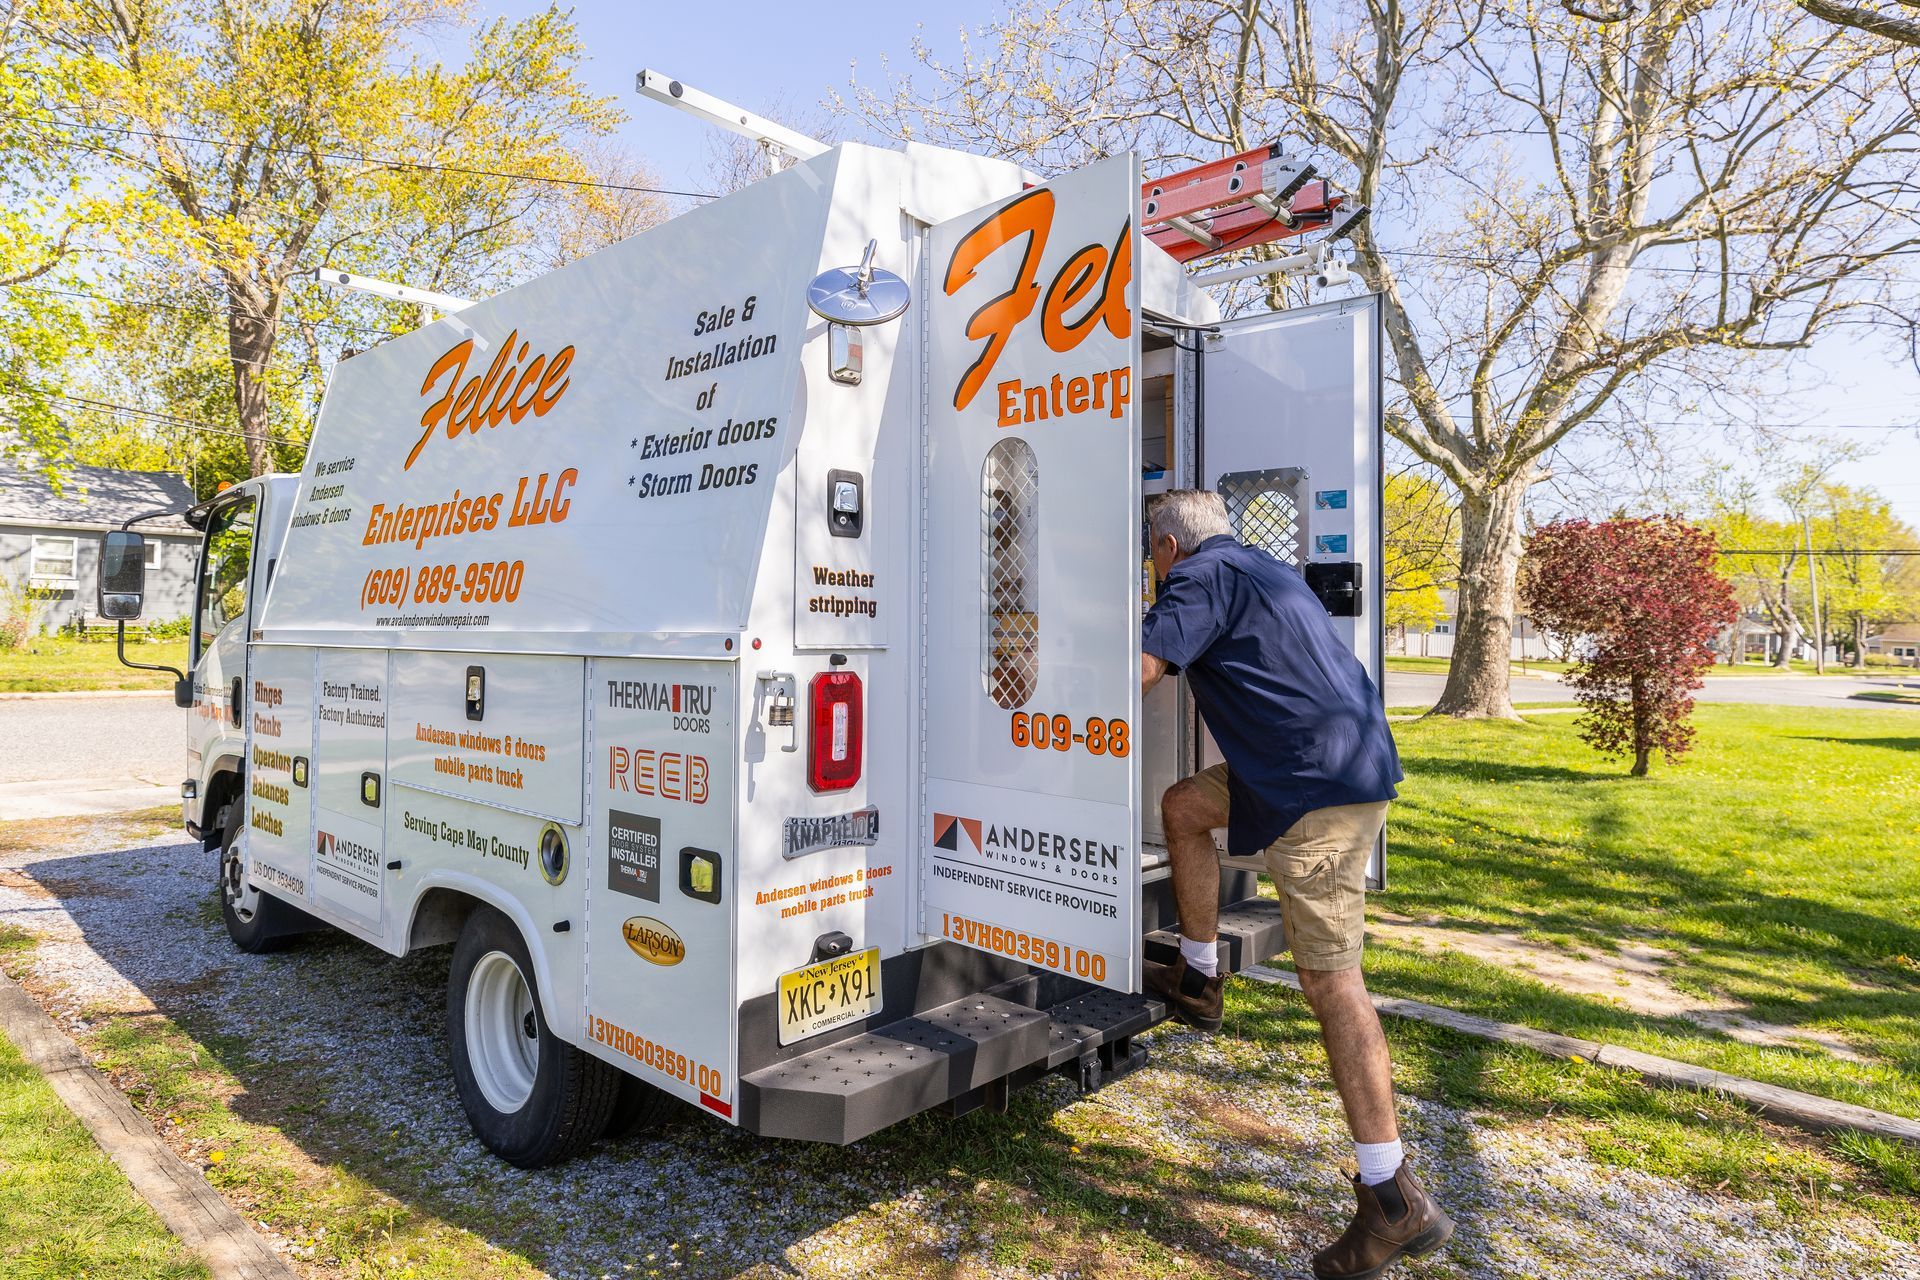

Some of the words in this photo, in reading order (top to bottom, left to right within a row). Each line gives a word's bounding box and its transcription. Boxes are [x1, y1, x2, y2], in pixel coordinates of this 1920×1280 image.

[693, 305, 736, 336] Sale
[741, 295, 757, 322] &
[665, 334, 777, 381] Installation
[404, 328, 576, 471] Felice
[696, 382, 718, 411] of
[997, 365, 1131, 428] Enterp
[640, 426, 713, 460] Exterior
[717, 417, 778, 447] doors
[314, 461, 327, 478] We
[326, 456, 355, 475] service
[638, 472, 693, 499] Storm
[698, 463, 759, 491] Doors
[309, 484, 345, 502] Andersen
[362, 489, 504, 550] Enterprises
[507, 468, 579, 528] LLC
[290, 511, 321, 528] windows
[321, 508, 329, 524] &
[328, 507, 352, 523] doors
[360, 566, 410, 611] (609)
[413, 560, 525, 604] 889-9500
[813, 566, 875, 588] Weather
[375, 613, 490, 629] www.avalondoorwindowrepair.com
[809, 595, 877, 618] stripping
[254, 681, 283, 709] Hinges
[323, 681, 349, 702] Factory
[607, 680, 671, 712] THERMA
[254, 712, 281, 738] Cranks
[319, 704, 344, 726] Factory
[346, 707, 385, 728] Authorized
[673, 716, 710, 734] DOORS
[415, 722, 456, 747] Andersen
[459, 730, 501, 754] windows
[504, 735, 512, 756] &
[515, 738, 546, 761] doors
[1011, 711, 1130, 758] 609-88
[253, 743, 291, 773] Operators
[434, 756, 465, 777] mobile
[468, 764, 493, 783] parts
[496, 766, 524, 789] truck
[252, 774, 289, 806] Balances
[609, 745, 709, 804] REEB
[251, 806, 283, 837] Latches
[611, 826, 658, 847] CERTIFIED
[788, 811, 876, 854] KNAPHEIDE
[335, 838, 379, 867] ANDERSEN
[404, 811, 438, 841] Serving
[440, 821, 464, 848] Cape
[467, 829, 488, 858] May
[491, 836, 530, 870] County
[611, 838, 629, 849] DOOR
[631, 843, 657, 855] SYSTEM
[253, 860, 263, 876] US
[263, 864, 276, 882] DOT
[611, 846, 657, 869] INSTALLER
[985, 850, 1046, 870] WINDOWS
[1054, 864, 1062, 873] &
[1071, 868, 1118, 885] DOORS
[316, 865, 342, 882] INDEPENDENT
[341, 875, 358, 890] SERVICE
[357, 882, 379, 898] PROVIDER
[755, 884, 807, 905] Andersen
[809, 873, 854, 893] windows
[856, 869, 863, 881] &
[866, 865, 892, 880] doors
[933, 864, 1005, 892] INDEPENDENT
[1007, 881, 1052, 903] SERVICE
[1055, 892, 1118, 919] PROVIDER
[781, 901, 818, 919] mobile
[820, 893, 846, 911] parts
[848, 885, 874, 902] truck
[627, 923, 680, 957] LARSON
[943, 913, 1106, 982] 13VH60359100
[805, 968, 828, 980] New
[829, 959, 857, 976] Jersey
[786, 980, 826, 1025] XKC
[839, 965, 875, 1008] X91
[812, 1010, 856, 1030] COMMERCIAL
[588, 1014, 722, 1097] 13VH060359100
